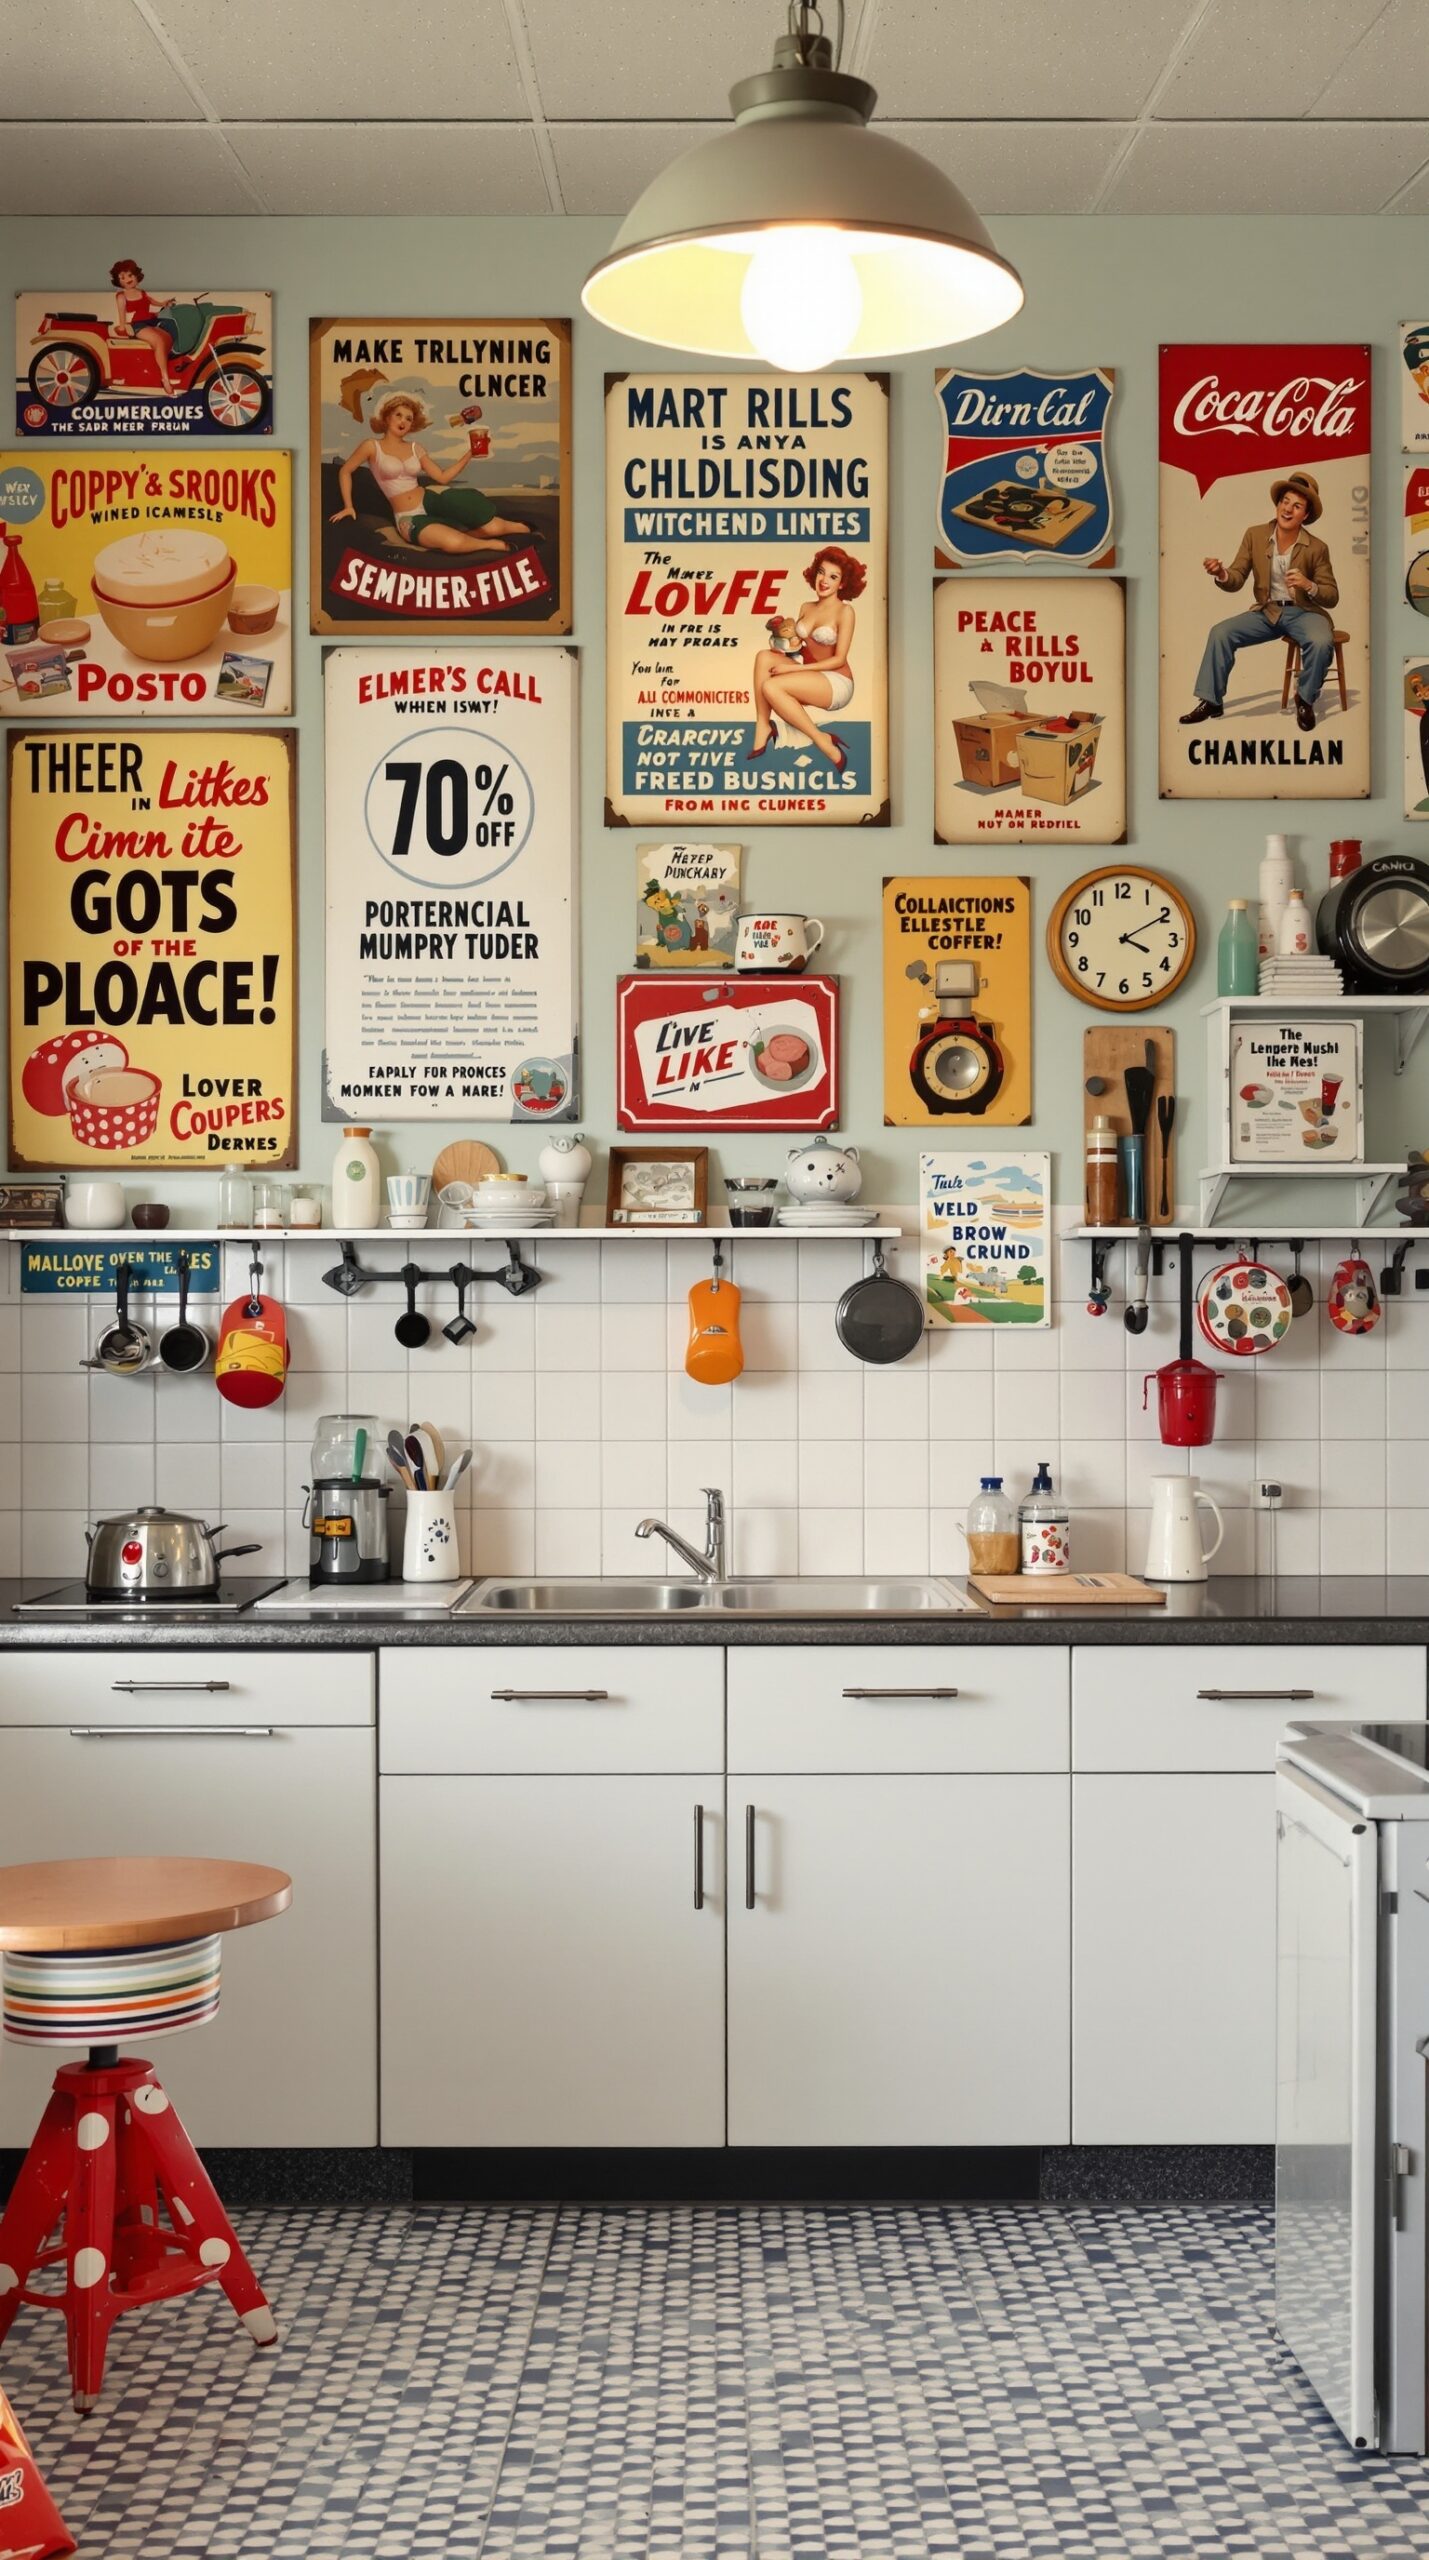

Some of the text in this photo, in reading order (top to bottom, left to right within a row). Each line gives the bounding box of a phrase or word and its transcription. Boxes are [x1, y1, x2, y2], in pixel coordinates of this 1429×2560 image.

[333, 340, 551, 364] MAKE TRLLYNING
[459, 374, 547, 397] CLNCER
[71, 406, 204, 420] COLUMERLOVES
[628, 388, 853, 428] MART RILLS
[952, 388, 1096, 427] Dirn-Cal
[1173, 375, 1366, 437] Coca-Cola
[51, 423, 74, 432] THE
[702, 435, 806, 450] IS ANYA
[624, 458, 869, 499] CHLDLISDING
[169, 469, 276, 528] SROOKS
[91, 507, 140, 524] WINED
[634, 513, 861, 535] WITCHEND LINTES
[644, 552, 671, 565] The
[661, 624, 675, 633] IN
[708, 624, 722, 633] IS
[958, 611, 1036, 632] PEACE
[1006, 635, 1079, 656] RILLS
[1010, 662, 1093, 683] BOYUL
[359, 666, 542, 704] ELMER'S CALL
[637, 752, 736, 767] NOT TIVE
[1188, 739, 1343, 765] CHANKLLAN
[25, 743, 143, 793] THEER
[635, 771, 857, 790] FREED BUSNICLS
[132, 798, 151, 810] IN
[665, 799, 714, 811] FROM
[475, 822, 515, 848] OFF
[1092, 890, 1104, 906] 11
[1114, 882, 1131, 900] 12
[1145, 889, 1151, 905] 1
[70, 869, 238, 935] GOTS
[365, 900, 530, 928] PORTERNCIAL
[1074, 909, 1092, 926] 10
[1159, 907, 1170, 924] 2
[113, 939, 197, 957] OF THE
[360, 933, 540, 960] MUMPRY TUDER
[928, 933, 1003, 950] COFFER!
[1068, 932, 1080, 948] 9
[1168, 933, 1179, 948] 3
[1077, 956, 1089, 972] 8
[1159, 956, 1171, 972] 4
[1096, 972, 1107, 988] 7
[1118, 978, 1129, 994] 6
[1142, 972, 1153, 988] 5
[23, 954, 280, 1027] PLOACE!
[1280, 1028, 1303, 1041] The
[656, 1040, 738, 1086] LIKE
[452, 1066, 507, 1078] PRONCES
[410, 1085, 440, 1097] FOW
[445, 1085, 455, 1097] A
[953, 1226, 1007, 1240] BROW
[109, 1252, 144, 1266] OVEN
[149, 1251, 172, 1263] THE
[966, 1244, 1030, 1259] CRUND
